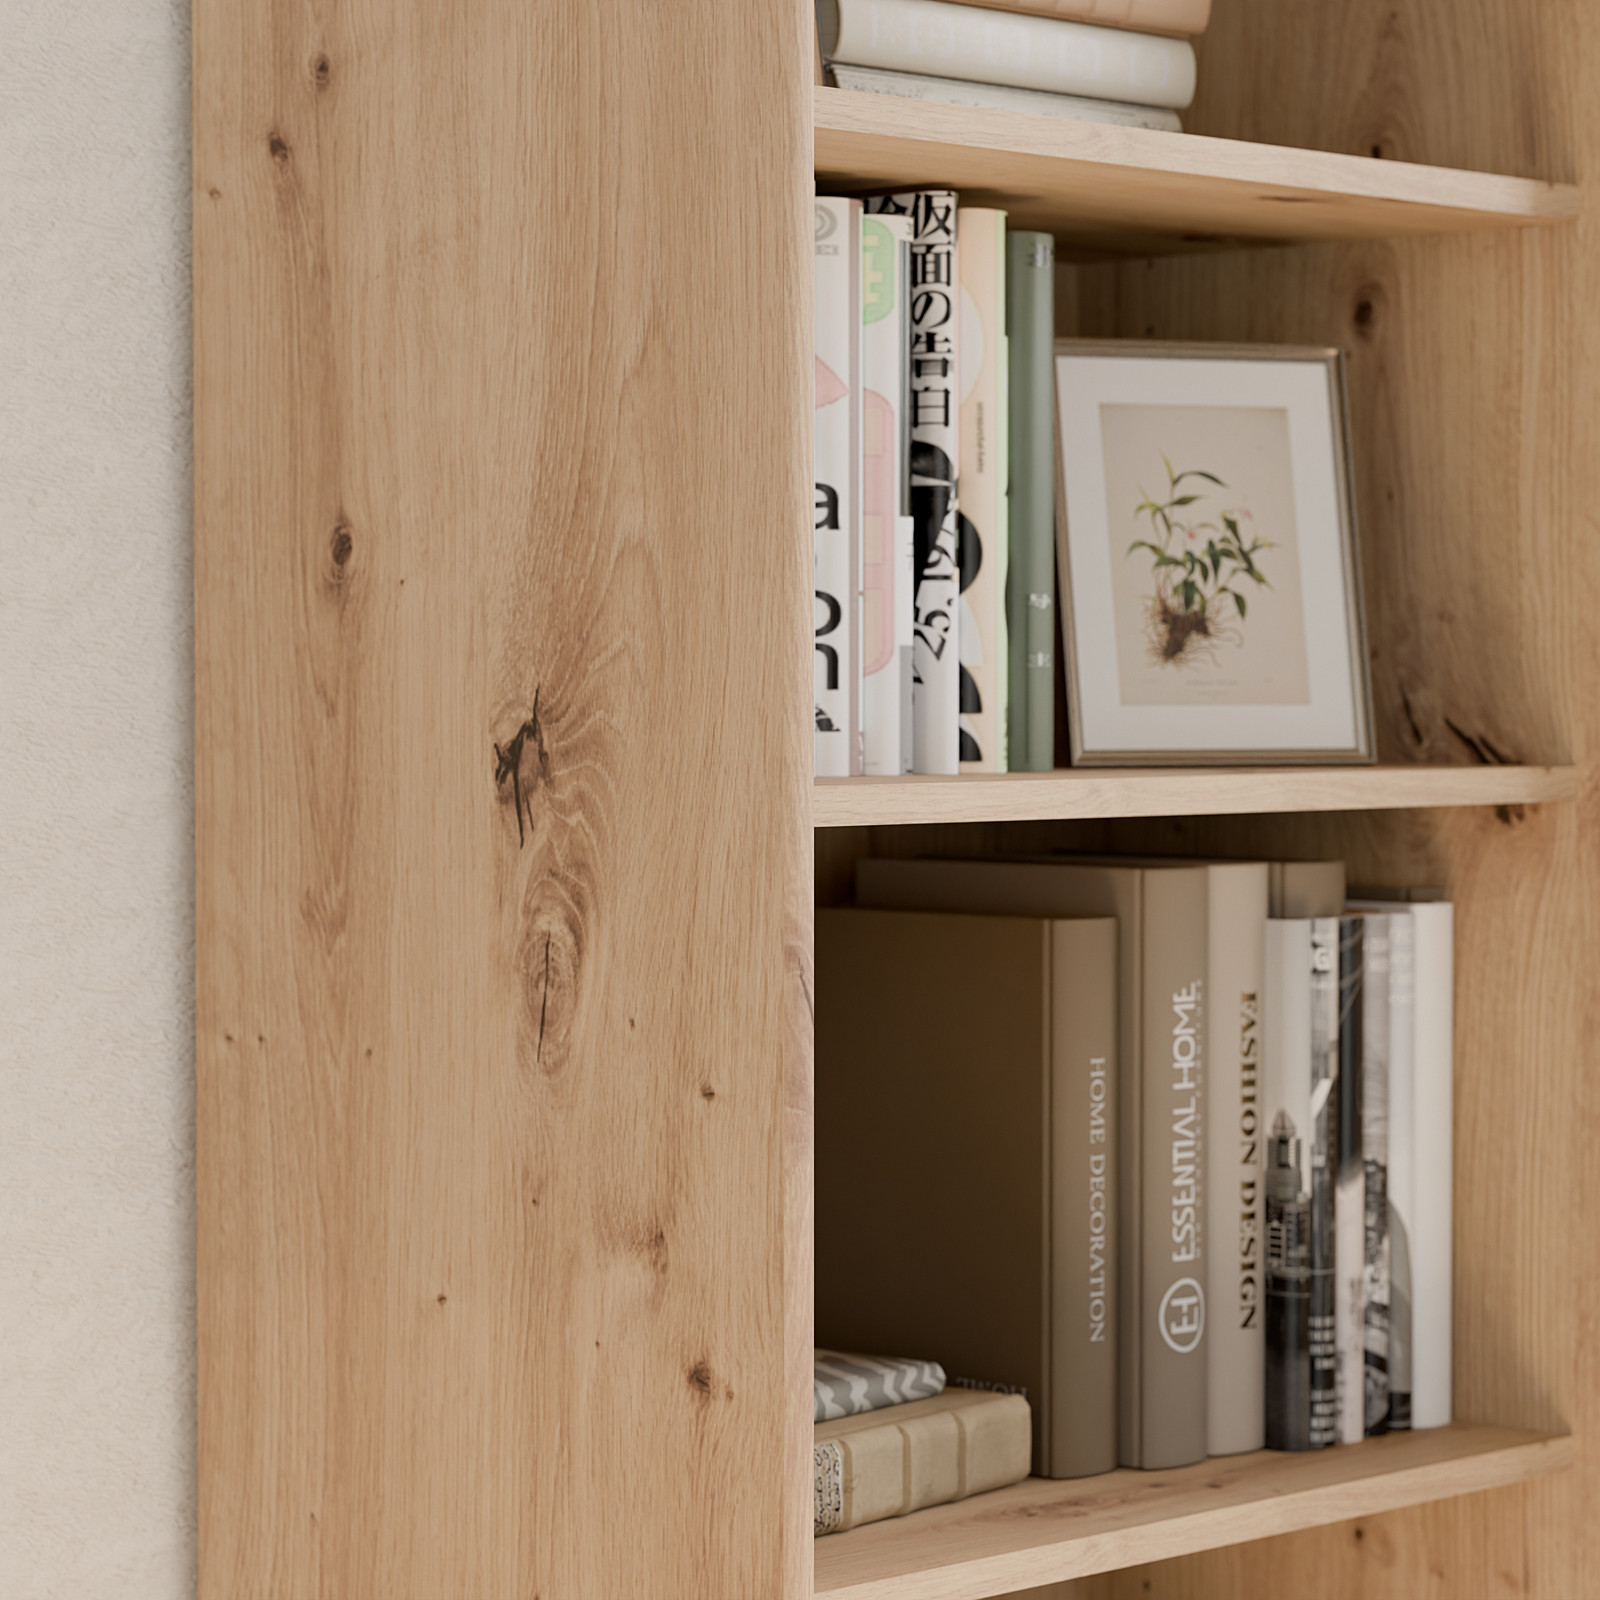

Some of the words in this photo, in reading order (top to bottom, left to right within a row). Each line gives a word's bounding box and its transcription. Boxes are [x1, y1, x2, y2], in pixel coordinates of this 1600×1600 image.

[911, 191, 953, 428] 仮面の告白
[1089, 1057, 1106, 1145] HOME
[1172, 981, 1196, 1090] HOME
[1240, 992, 1257, 1165] FASHION
[1089, 1154, 1106, 1343] DECORATION
[1171, 1096, 1196, 1263] ESSENTIAL
[1240, 1181, 1257, 1330] DESIGN
